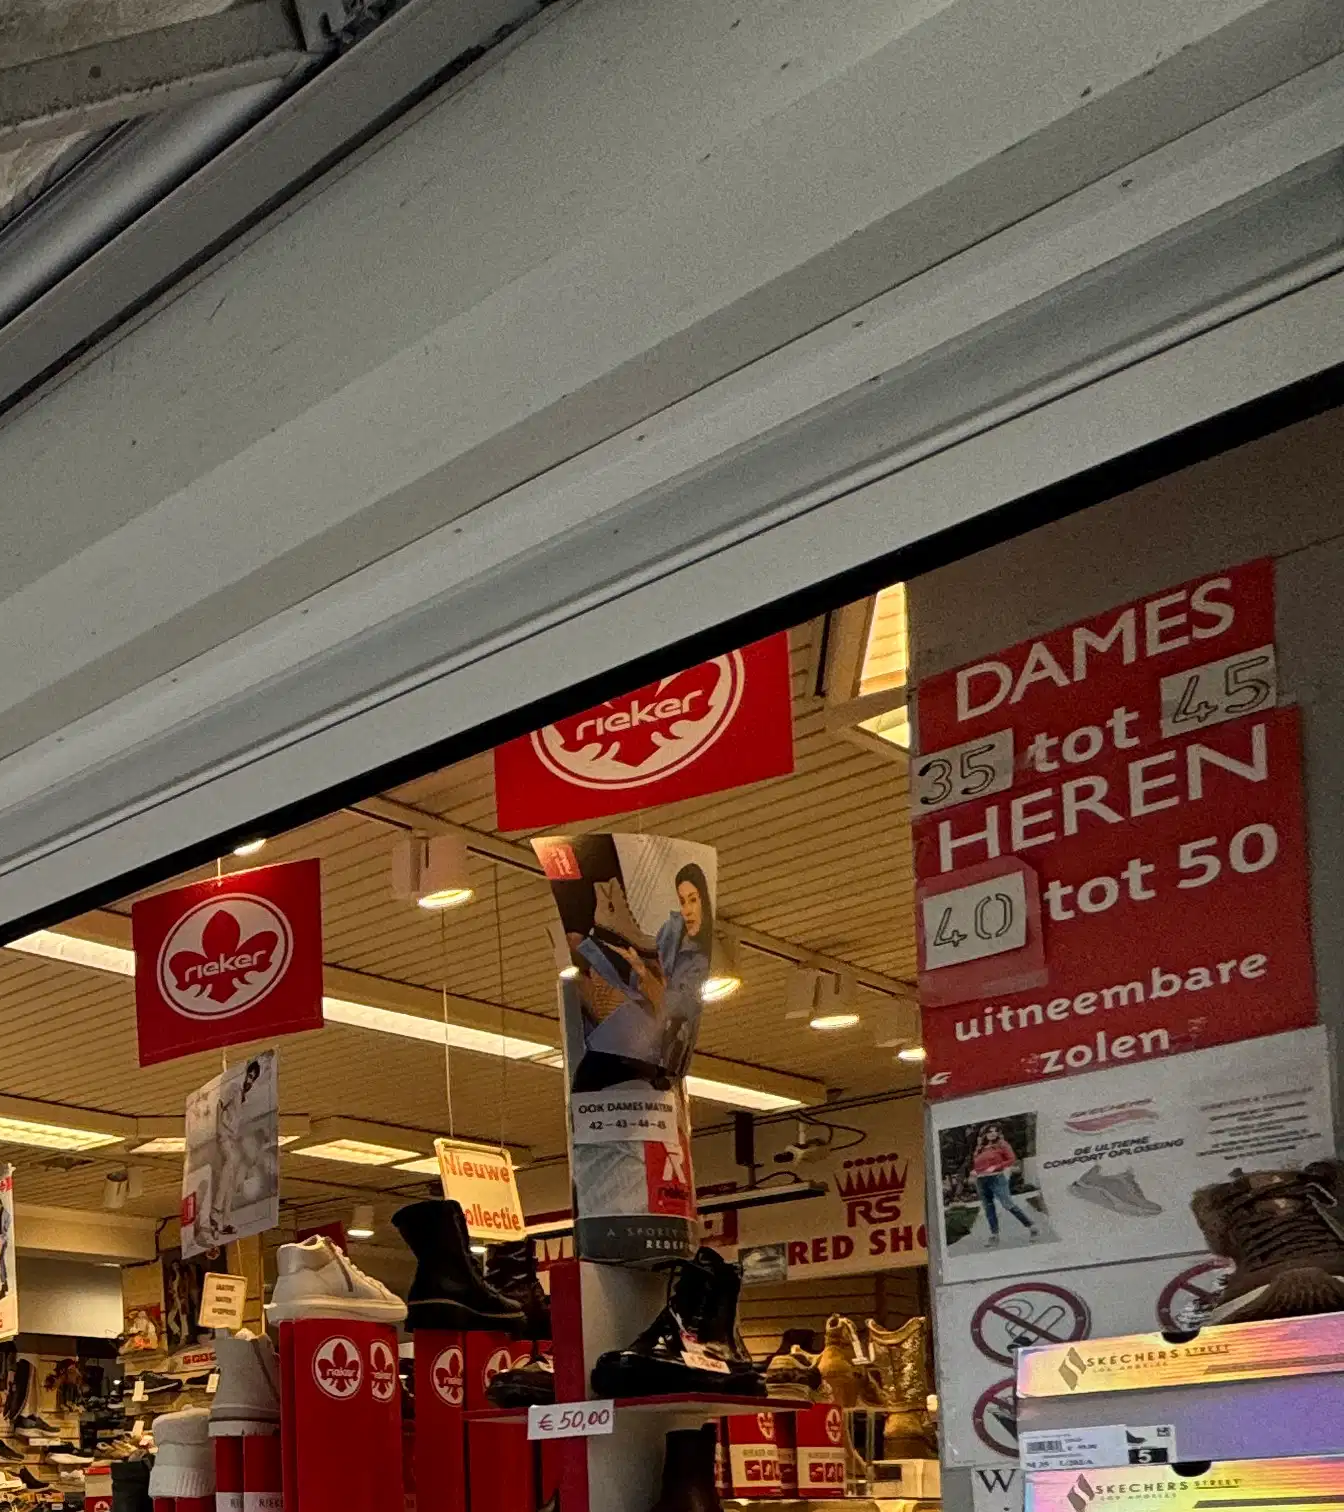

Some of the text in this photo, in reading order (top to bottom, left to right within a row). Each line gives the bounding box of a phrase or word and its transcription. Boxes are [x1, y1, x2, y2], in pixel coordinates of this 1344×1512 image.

[956, 577, 1235, 723] DAMES
[575, 688, 704, 742] rieker
[919, 655, 1270, 806] 35 tot 45
[939, 723, 1268, 873] HEREN
[933, 822, 1279, 949] 40 tot 50
[183, 949, 268, 983] rieker
[954, 951, 1269, 1042] uitneembare
[1040, 1025, 1171, 1074] zolen
[578, 1103, 604, 1114] OOK
[607, 1101, 644, 1112] DAMES
[588, 1120, 603, 1130] 42
[1043, 1138, 1185, 1169] COMFORT OPLOSSING
[1074, 1136, 1151, 1155] DE ULTIEME
[444, 1151, 511, 1184] Nieuwe
[463, 1204, 521, 1231] ollectie
[787, 1235, 854, 1266] RED
[1087, 1343, 1231, 1367] SKECHERS STREET
[537, 1408, 611, 1431] € 50,00
[1138, 1450, 1151, 1463] 5
[1095, 1478, 1242, 1495] SKECHERS STREET
